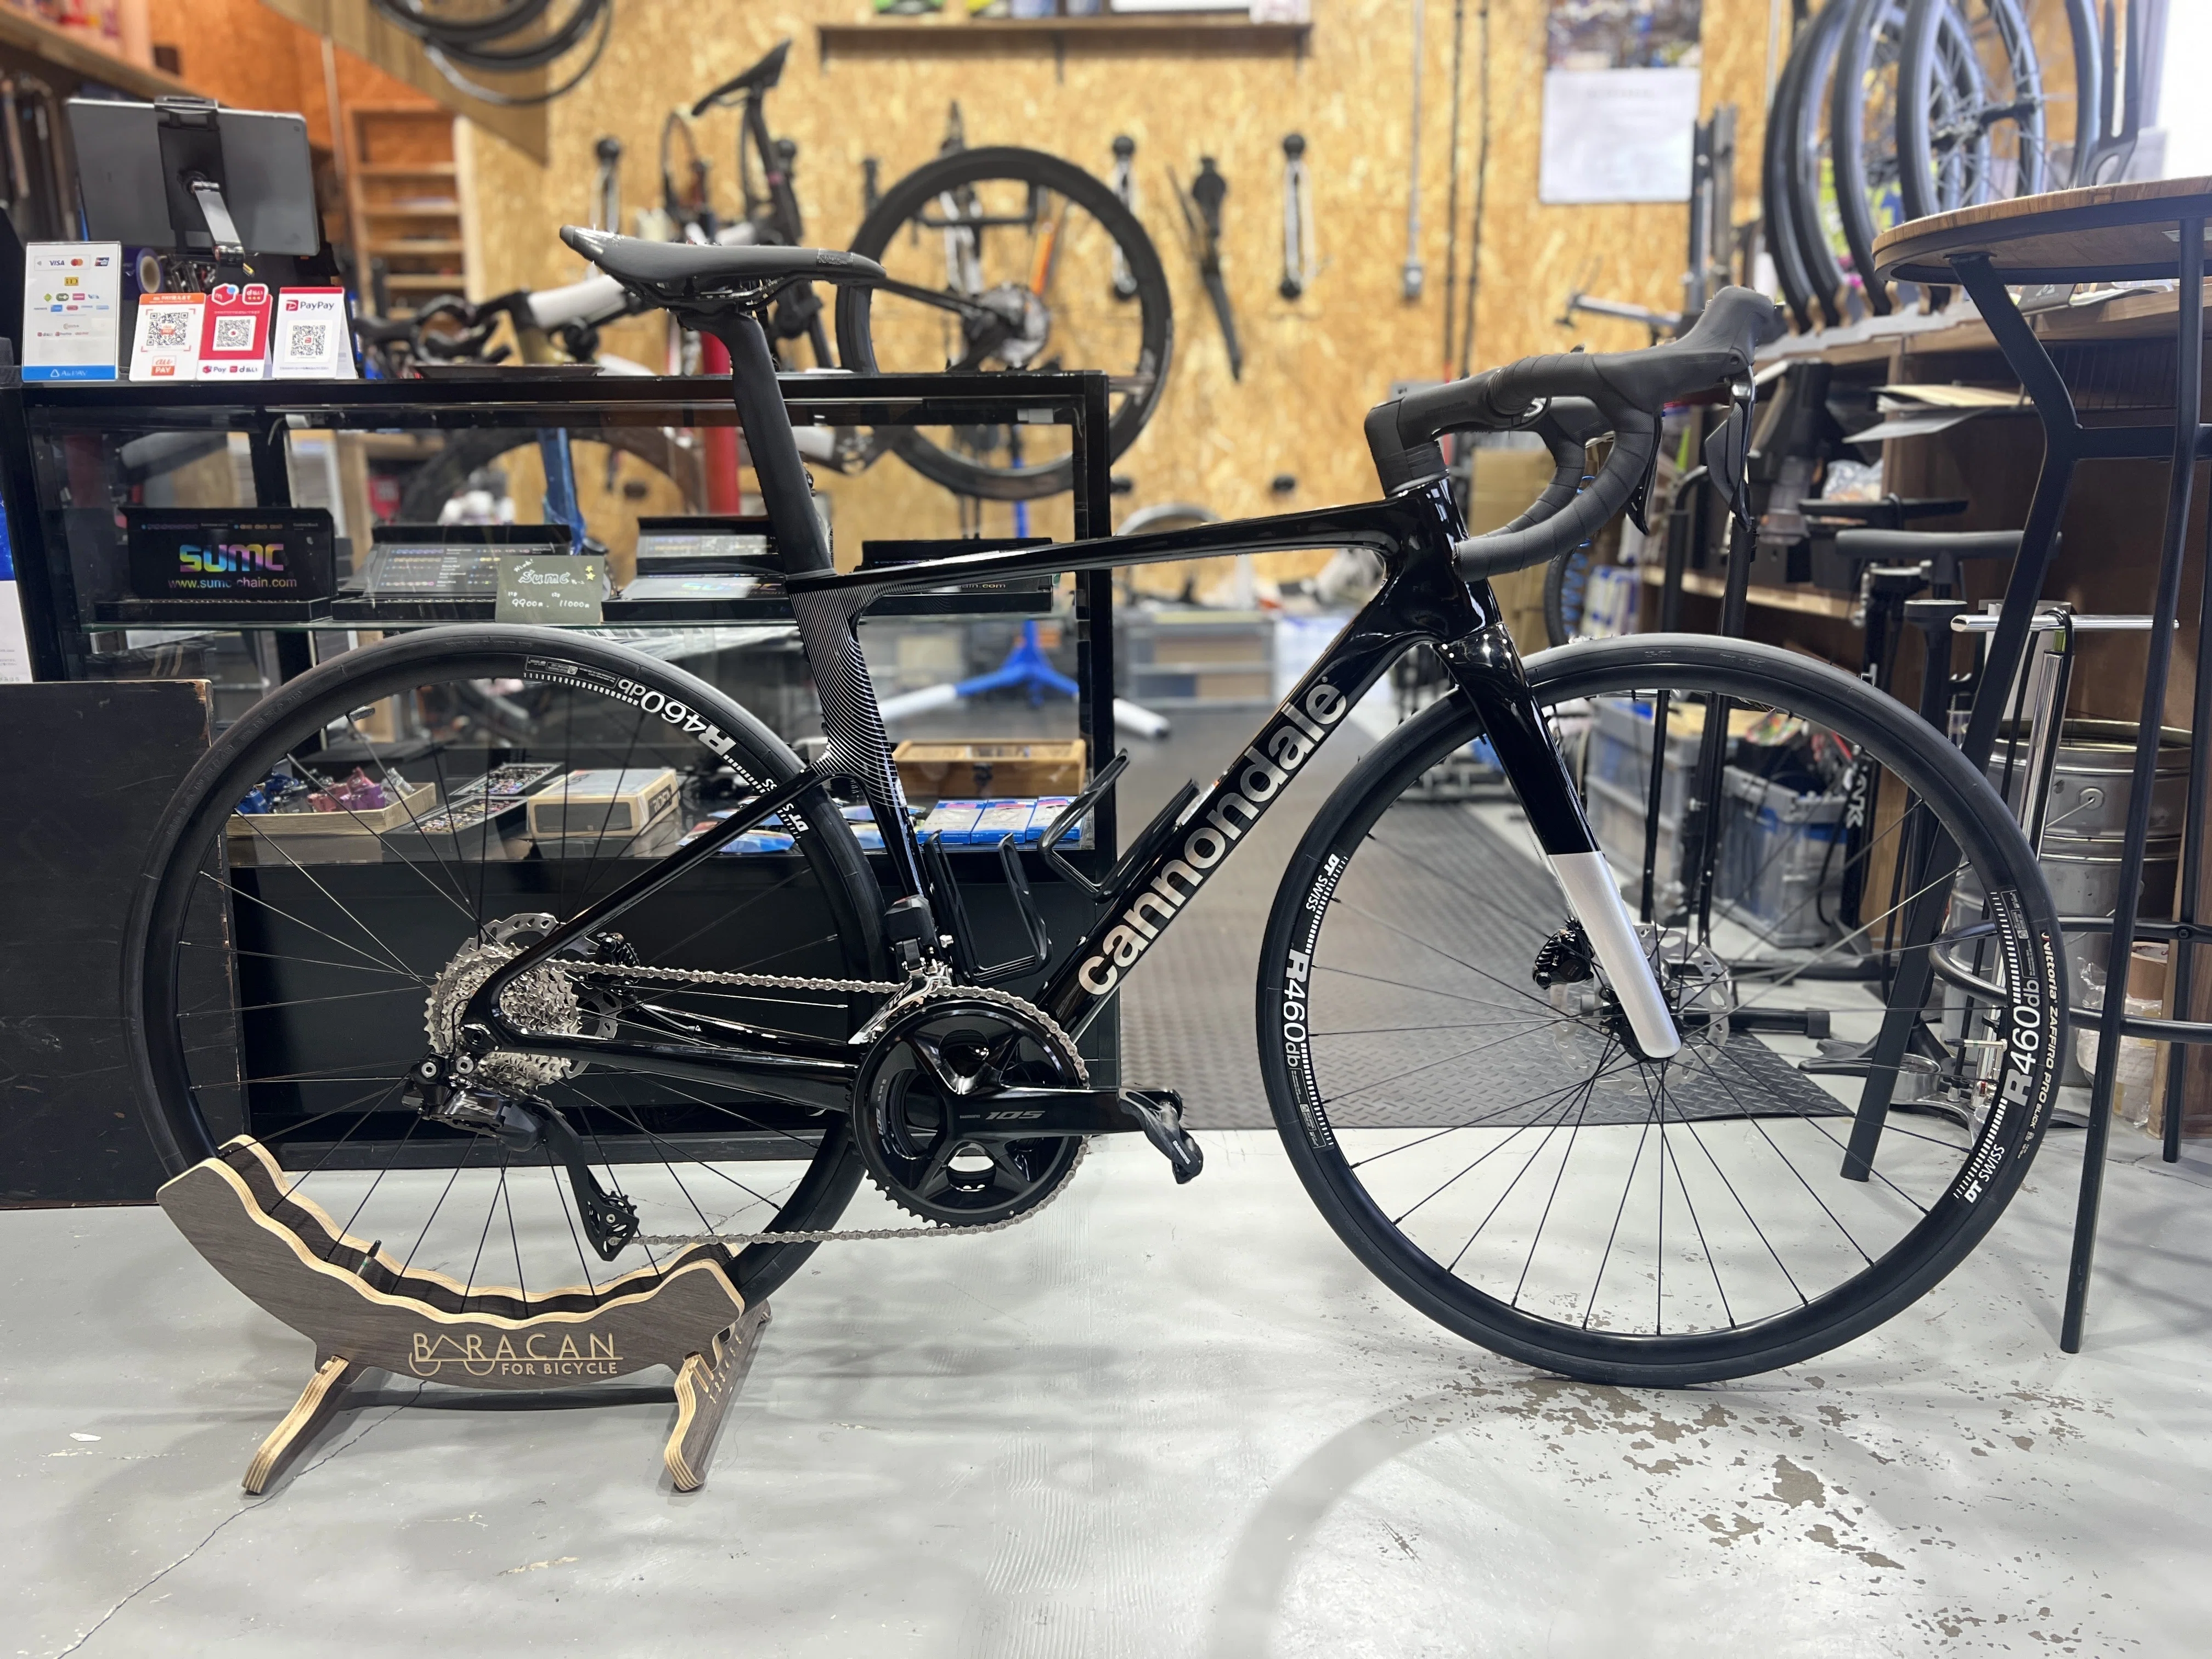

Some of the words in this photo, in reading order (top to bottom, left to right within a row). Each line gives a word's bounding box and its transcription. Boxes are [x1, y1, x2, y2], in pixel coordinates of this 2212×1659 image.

[300, 301, 335, 311] PayPay
[168, 577, 297, 588] www.sumcchain.com
[618, 678, 737, 756] R460db
[788, 813, 809, 833] DT
[1078, 684, 1347, 996] cannondale
[1323, 854, 1340, 876] DT
[1306, 874, 1328, 912] SWISS
[1283, 948, 1310, 1068] R460db
[2003, 978, 2040, 1107] R460db
[2045, 1007, 2058, 1069] ZAFFIRO
[2039, 1071, 2052, 1104] PRO
[985, 1110, 1046, 1120] 105
[2029, 1103, 2042, 1129] SLICK
[1963, 1180, 1984, 1204] DT
[1978, 1144, 2005, 1183] SWISS
[414, 1333, 616, 1359] BARACAN
[501, 1363, 535, 1375] FOR
[544, 1362, 618, 1375] BICYCLE
